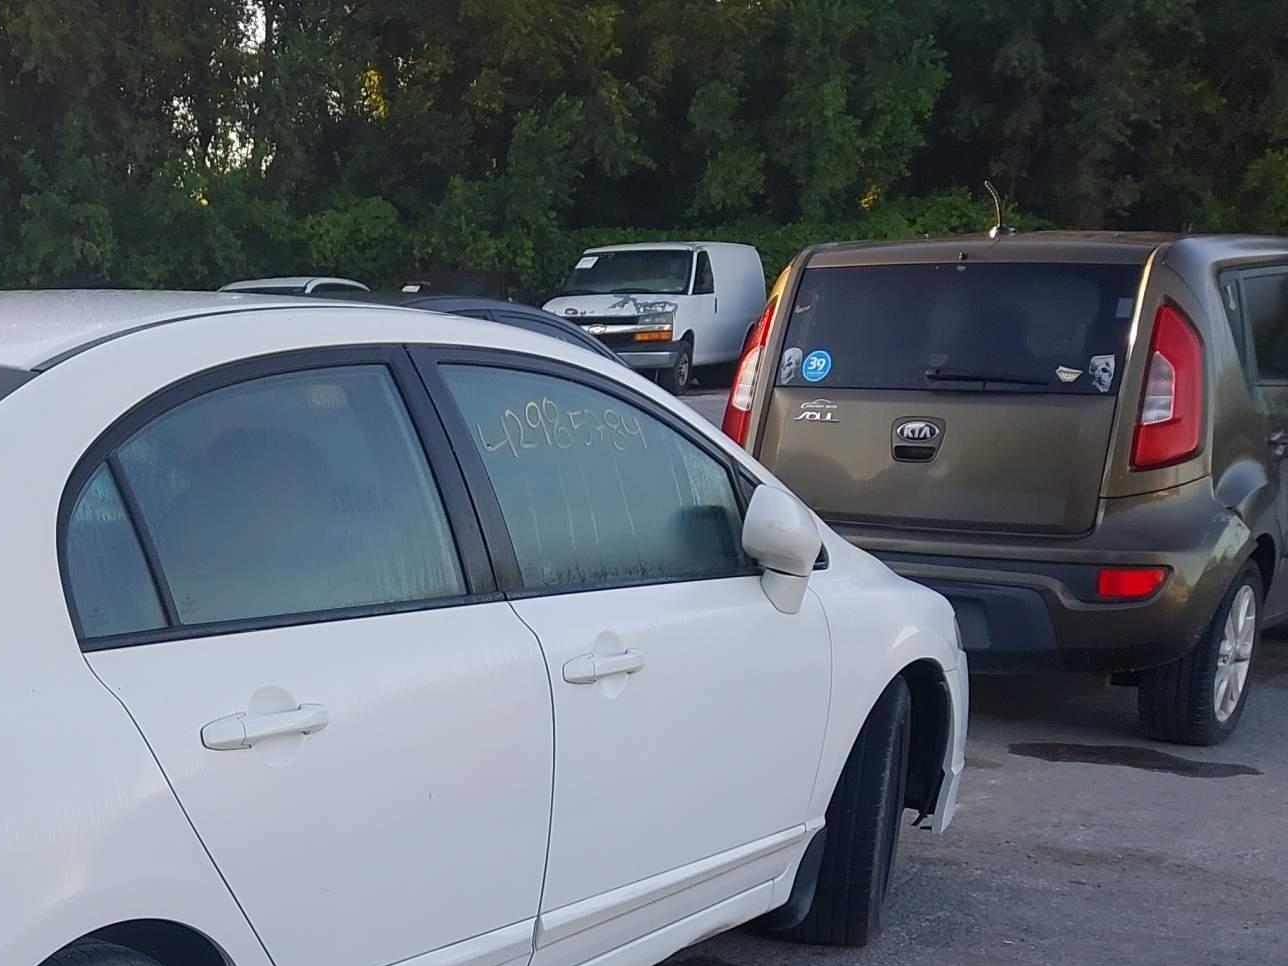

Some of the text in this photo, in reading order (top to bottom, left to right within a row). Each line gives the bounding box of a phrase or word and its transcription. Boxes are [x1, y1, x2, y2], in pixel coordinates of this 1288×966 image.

[807, 356, 826, 371] 39
[476, 396, 648, 459] 42985784
[903, 422, 931, 438] KIA
